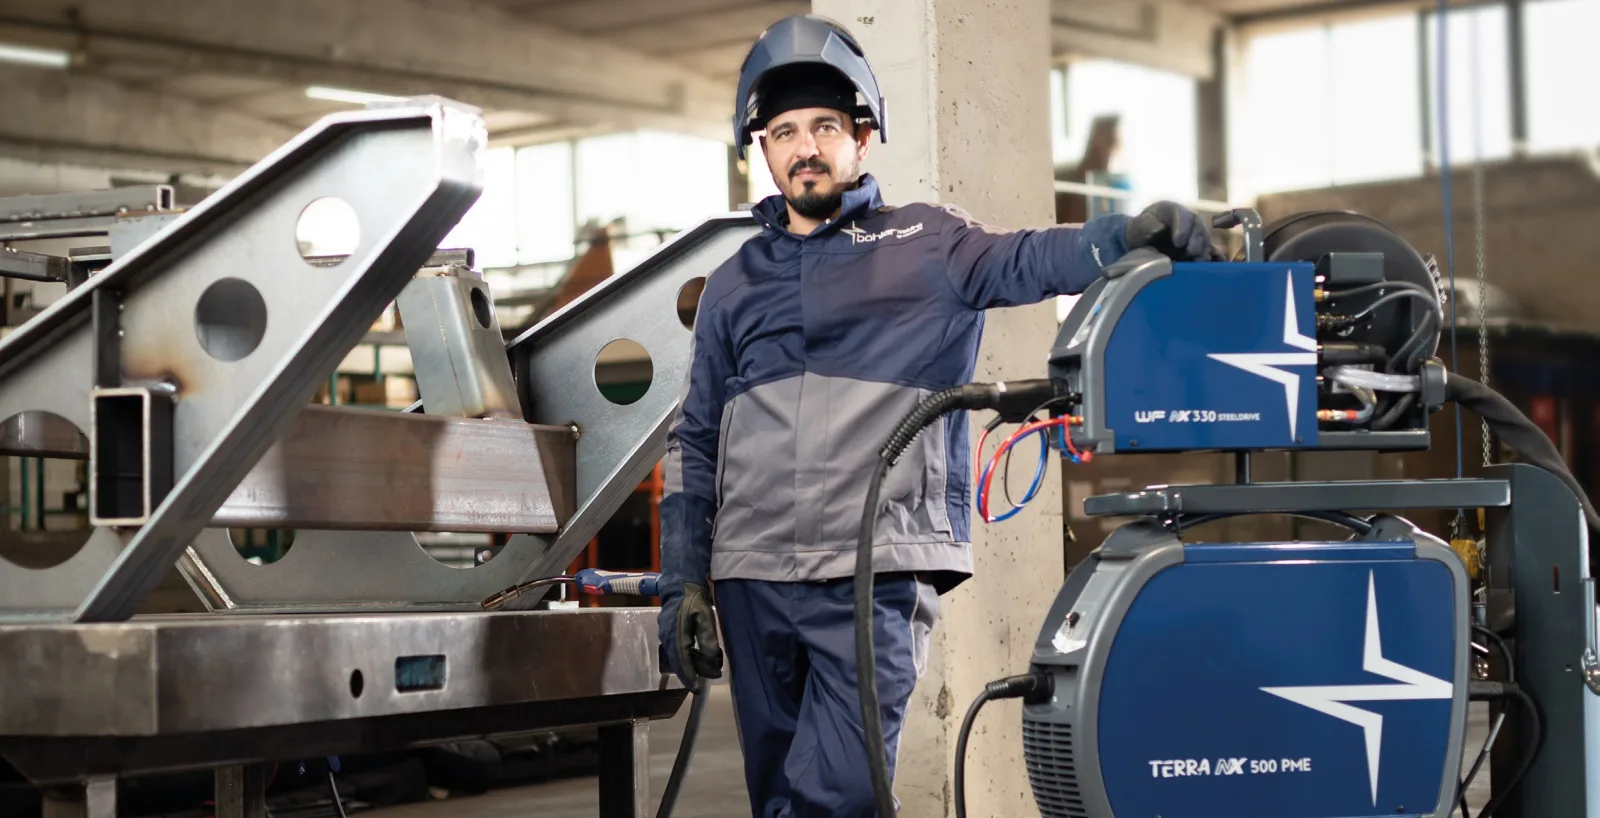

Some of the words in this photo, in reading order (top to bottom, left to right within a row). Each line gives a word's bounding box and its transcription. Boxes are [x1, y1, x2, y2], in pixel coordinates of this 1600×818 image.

[1134, 410, 1166, 423] WF
[1192, 410, 1216, 423] 330
[1217, 412, 1261, 422] STEELDRIVE
[1148, 758, 1211, 778] TERRA
[1214, 757, 1248, 776] NX
[1250, 759, 1278, 774] 500
[1280, 757, 1312, 773] PME
